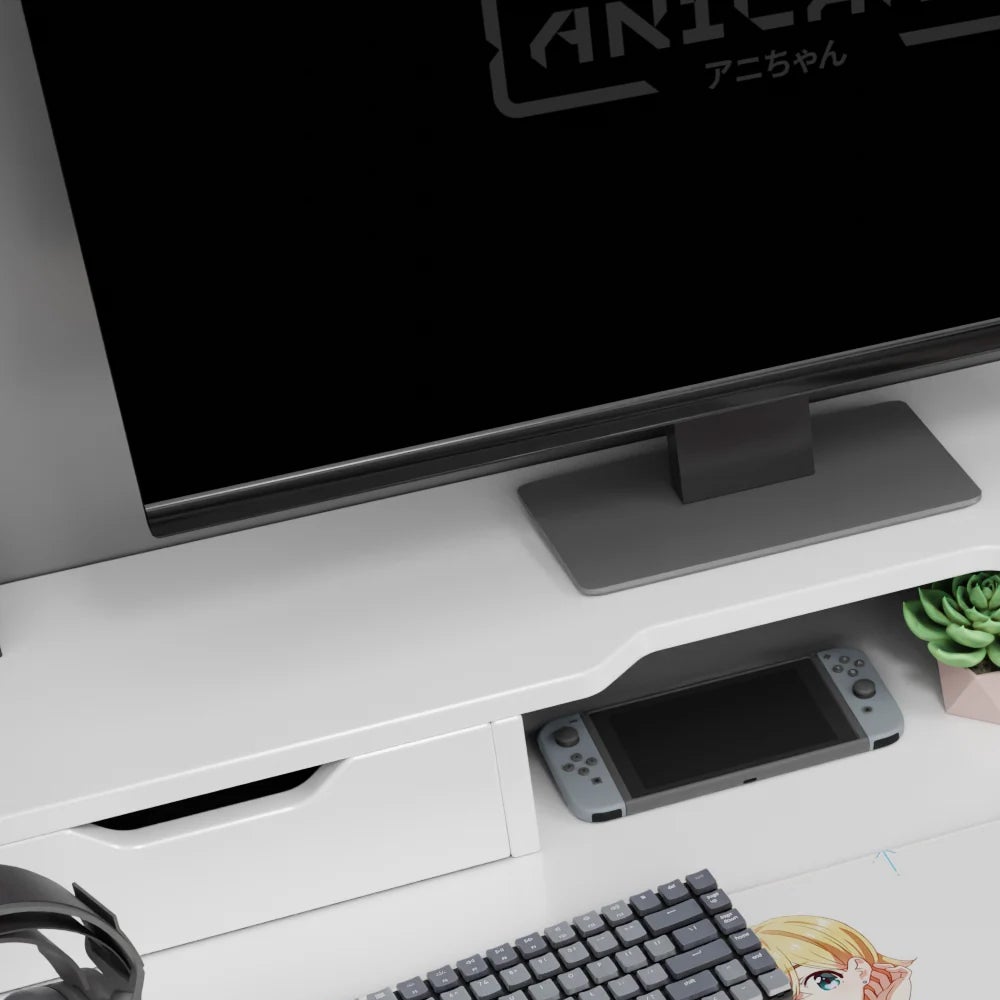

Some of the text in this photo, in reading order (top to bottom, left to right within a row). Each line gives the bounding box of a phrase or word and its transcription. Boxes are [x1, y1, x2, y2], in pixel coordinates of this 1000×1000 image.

[705, 39, 848, 90] アニちゃん
[734, 932, 750, 941] home
[752, 952, 763, 960] end
